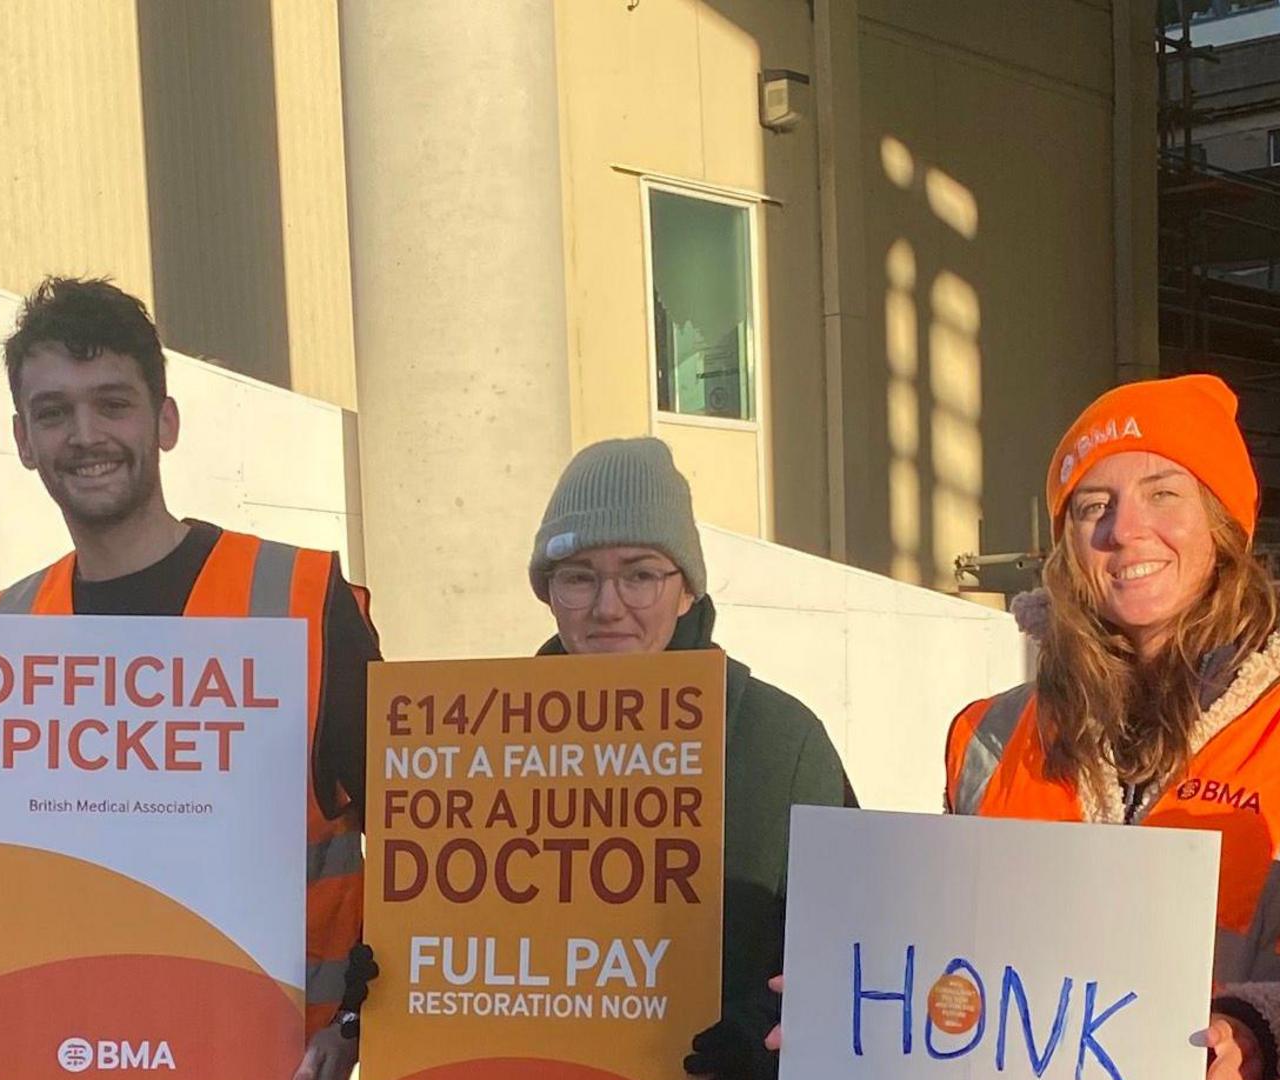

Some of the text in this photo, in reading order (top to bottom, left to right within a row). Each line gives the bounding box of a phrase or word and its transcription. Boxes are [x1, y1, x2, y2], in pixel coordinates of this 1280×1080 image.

[1075, 415, 1144, 458] BMA
[386, 686, 703, 737] £14/HOUR IS
[1, 719, 245, 771] PICKET
[384, 741, 703, 780] NOT A FAIR WAGE
[29, 798, 214, 814] British Medical Association
[383, 786, 703, 835] FOR A JUNIOR
[1202, 780, 1262, 816] BMA
[382, 837, 701, 904] DOCTOR
[409, 936, 671, 988] FULL PAY
[408, 991, 667, 1020] RESTORATION NOW
[97, 1040, 176, 1070] BMA
